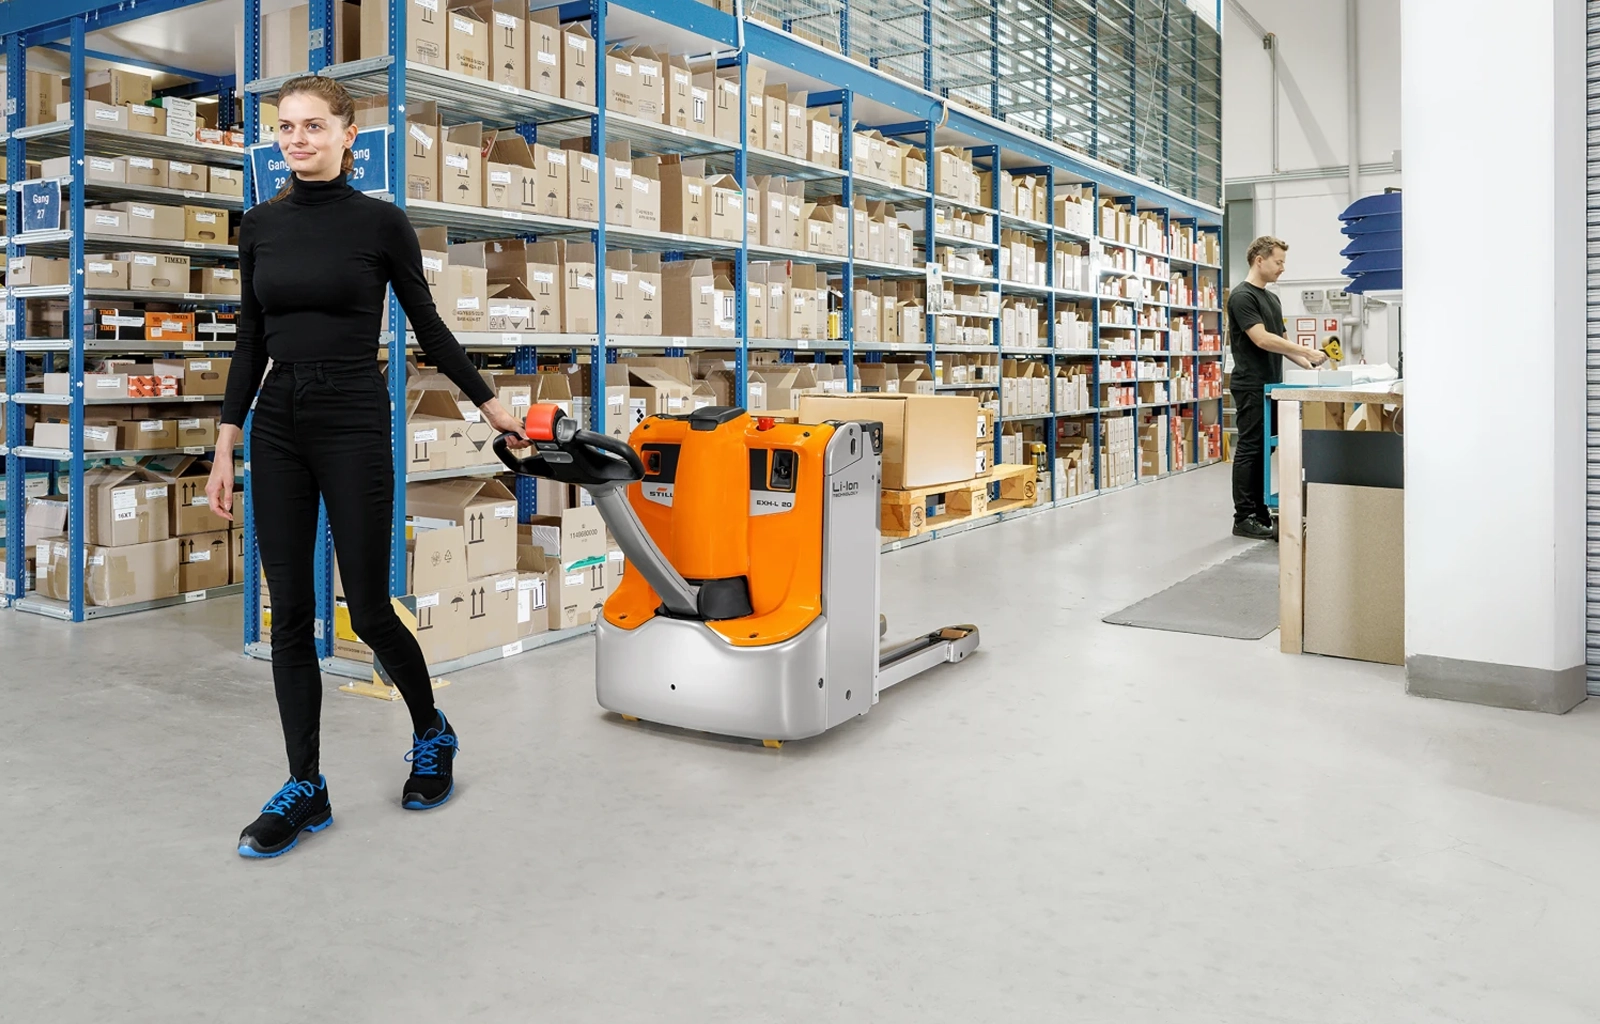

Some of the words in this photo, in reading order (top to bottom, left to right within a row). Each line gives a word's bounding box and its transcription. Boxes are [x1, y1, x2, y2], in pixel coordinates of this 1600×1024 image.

[351, 148, 370, 161] ang
[268, 160, 290, 171] Gang
[353, 168, 365, 179] 29
[33, 194, 50, 205] Gang
[36, 209, 45, 219] 27
[164, 256, 187, 265] TIMKEN
[832, 481, 859, 493] Li-Ion
